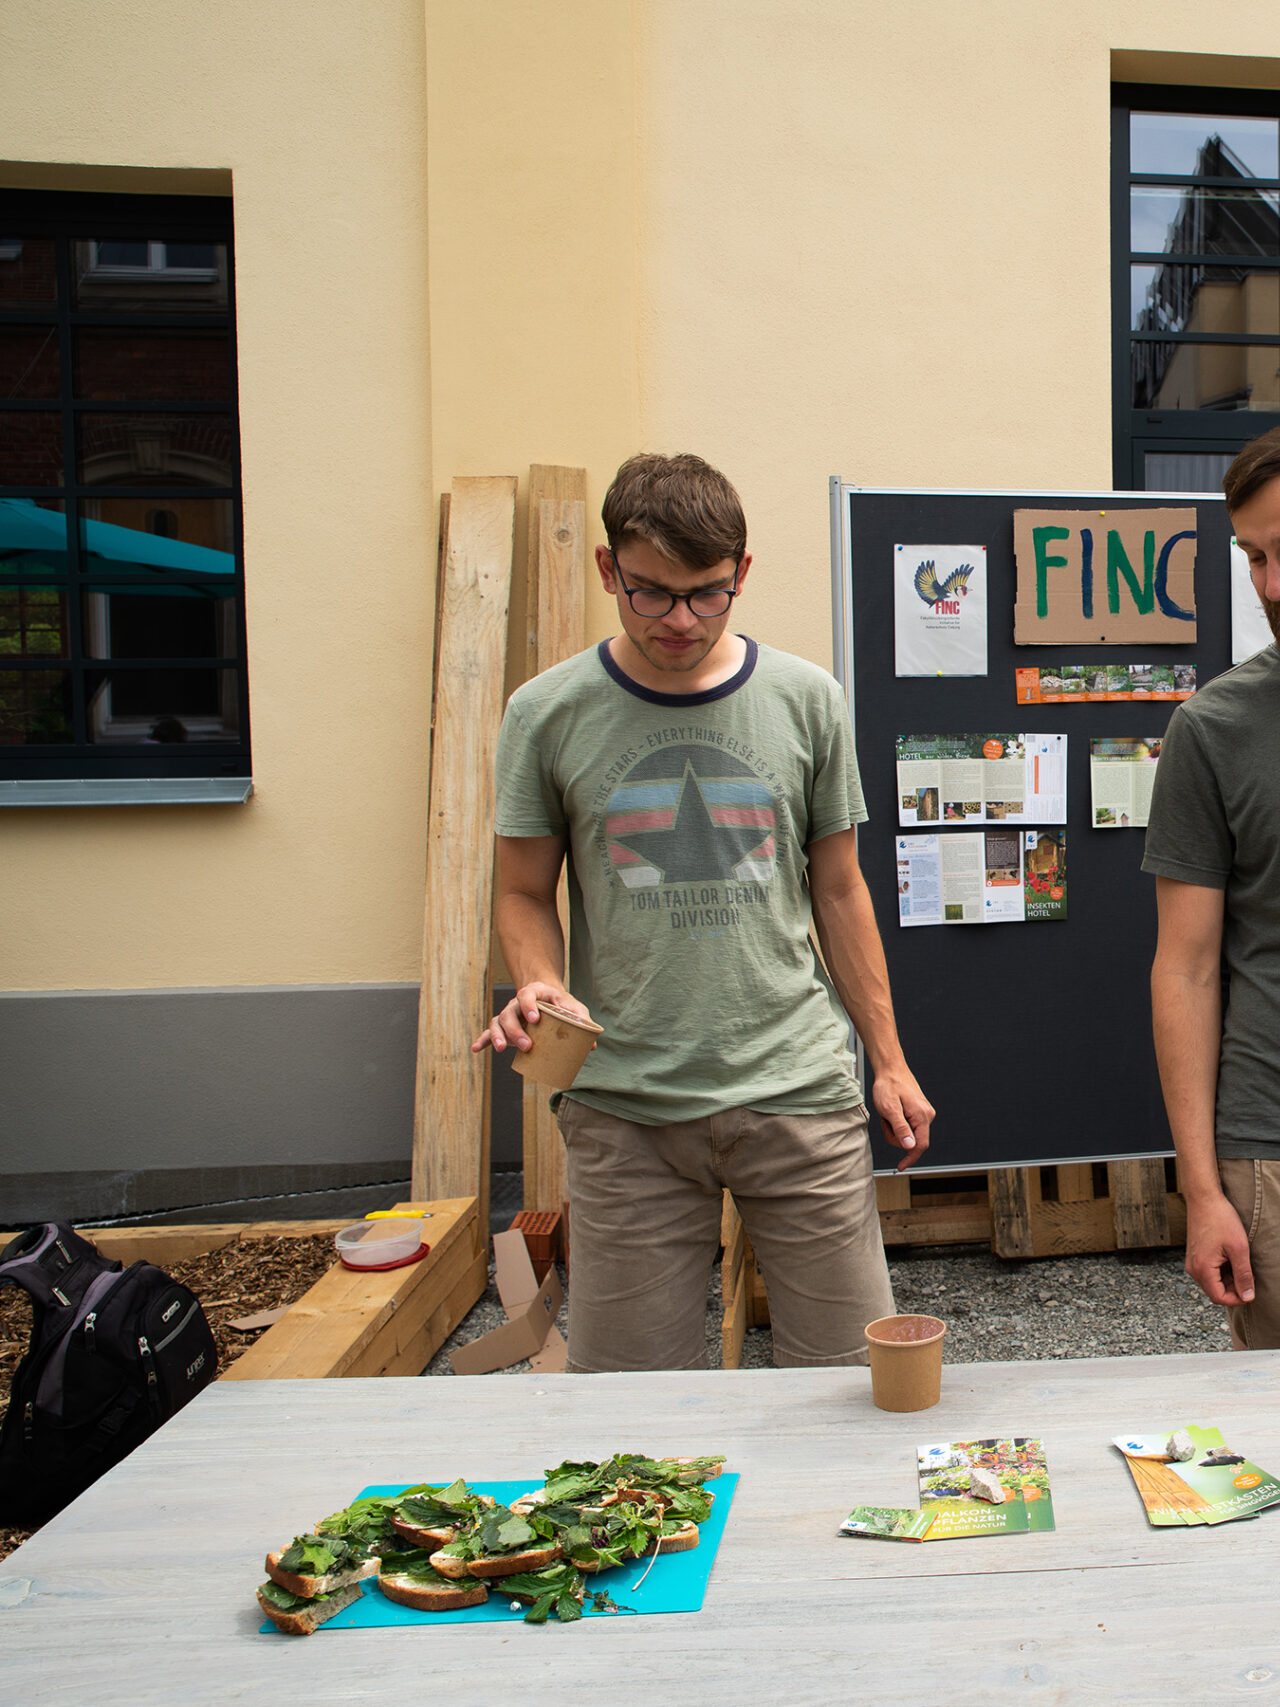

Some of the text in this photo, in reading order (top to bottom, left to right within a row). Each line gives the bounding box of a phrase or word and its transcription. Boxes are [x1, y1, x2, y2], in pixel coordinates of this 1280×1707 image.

[1032, 526, 1197, 621] FINC
[935, 600, 960, 615] FINC
[593, 784, 612, 807] THE
[607, 747, 638, 783] STARS
[646, 727, 724, 747] EVERYTHING
[726, 737, 756, 762] ELSE
[754, 758, 768, 772] IS
[765, 773, 776, 782] A
[630, 885, 770, 912] TOM TAILOR DENIM
[1027, 902, 1061, 910] INSEKTEN
[670, 908, 741, 929] DIVISION
[933, 1513, 1007, 1527] PFLANZEN
[972, 1521, 1007, 1530] NATUR
